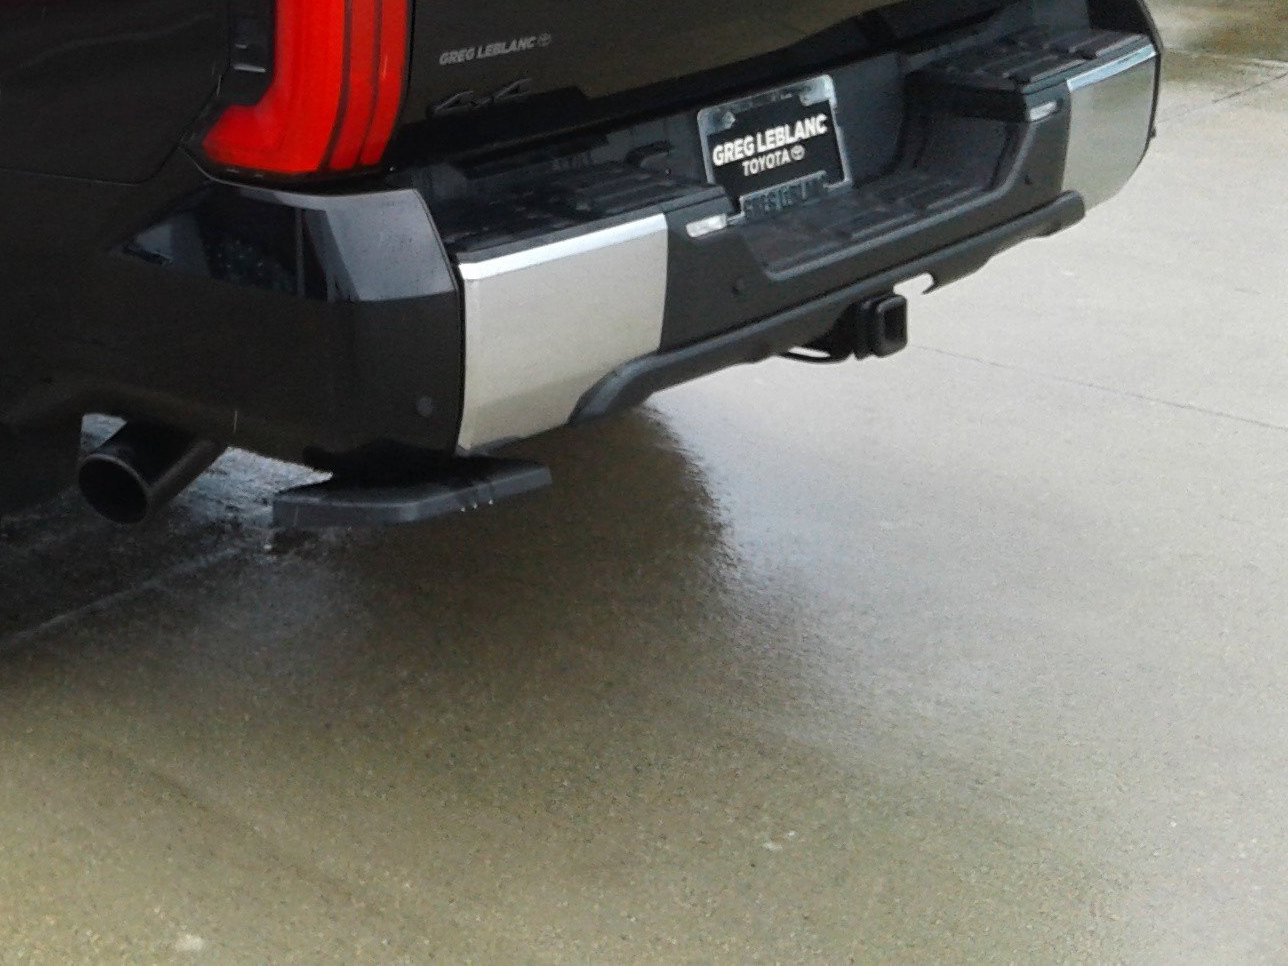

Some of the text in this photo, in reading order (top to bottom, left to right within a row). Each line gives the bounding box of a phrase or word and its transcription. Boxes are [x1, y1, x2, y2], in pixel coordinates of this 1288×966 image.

[439, 36, 537, 65] GREG LEBLANC
[712, 113, 828, 166] GREG LEBLANC
[742, 148, 792, 176] TOYOTA
